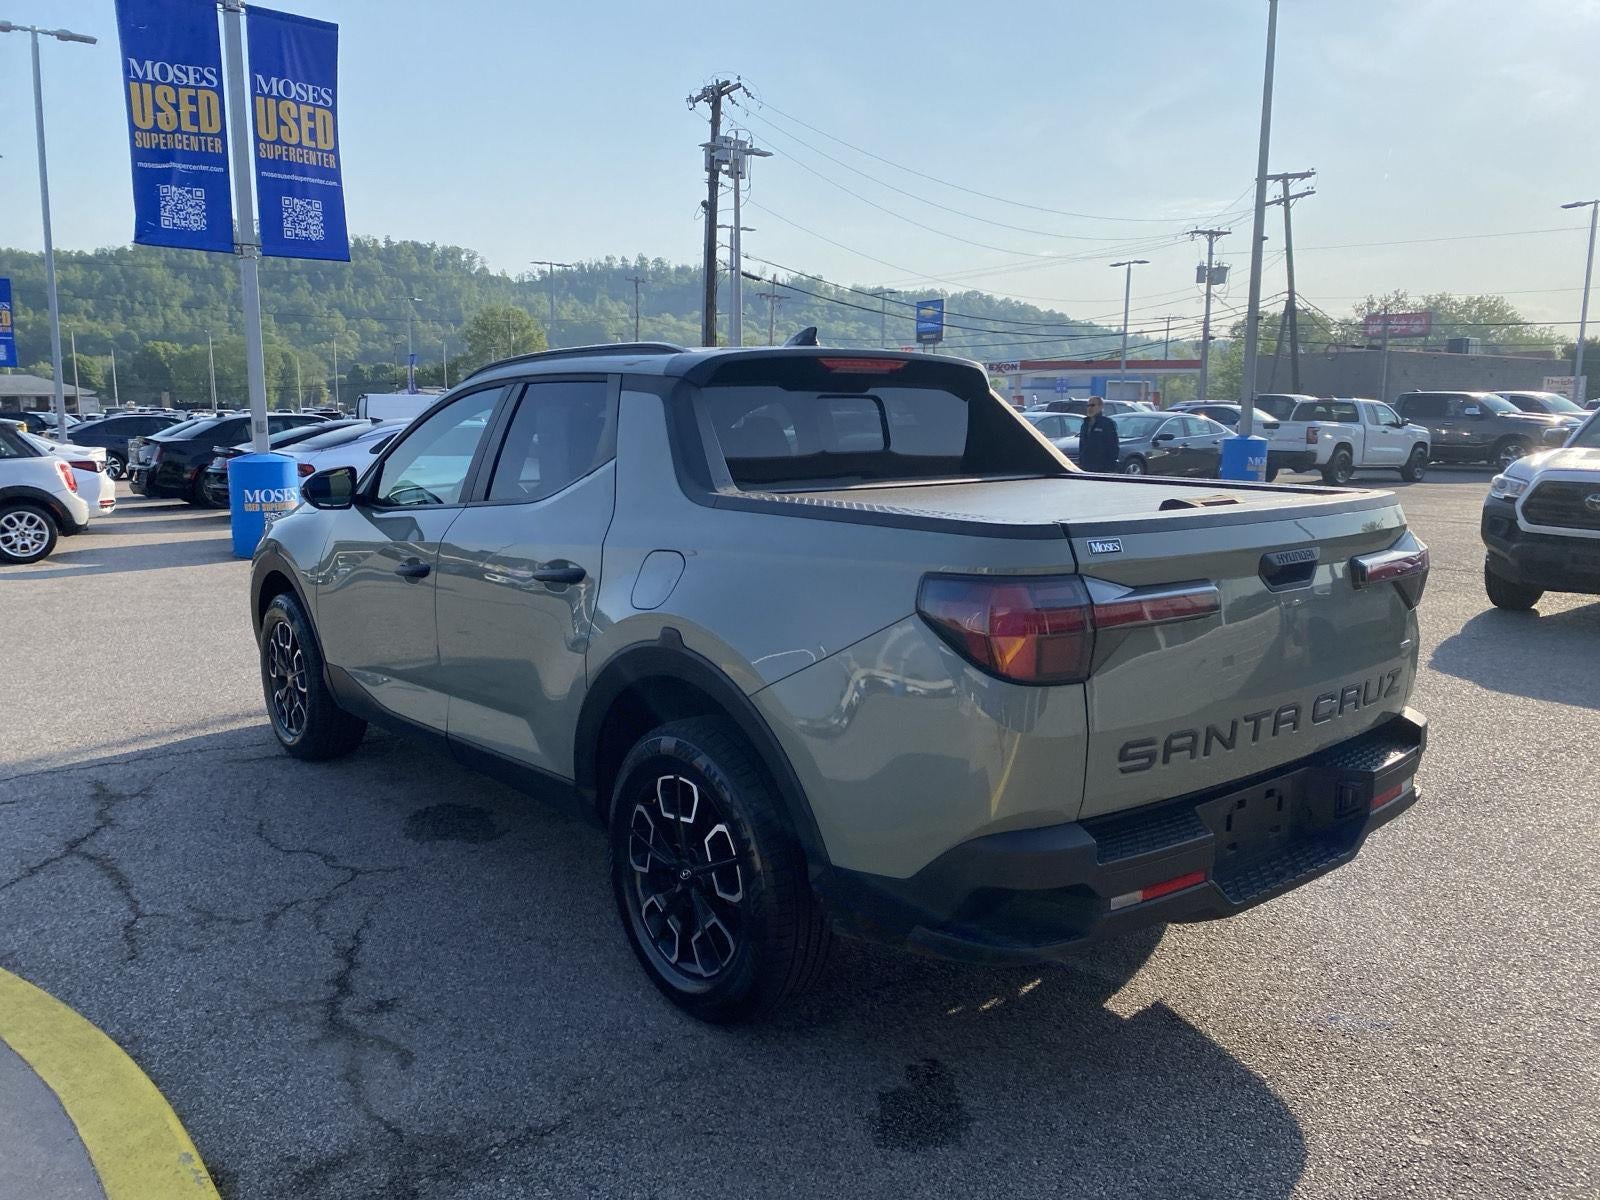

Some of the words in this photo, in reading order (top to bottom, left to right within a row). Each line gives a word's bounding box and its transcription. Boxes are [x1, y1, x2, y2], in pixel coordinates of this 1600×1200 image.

[128, 57, 218, 87] MOSES
[255, 74, 333, 107] MOSES
[130, 82, 221, 134] USED
[256, 96, 335, 151] USED
[135, 131, 223, 153] SUPERCENTER
[137, 160, 224, 173] mosesusedsupercenter.com
[259, 142, 337, 169] SUPERCENTER
[261, 171, 337, 186] mosesusedsupercenter.com
[988, 362, 1018, 373] EXXON
[244, 488, 297, 503] MOSES
[1090, 542, 1120, 553] MOSES
[1277, 550, 1315, 564] HYUNDAI
[1118, 702, 1302, 774] SANTA
[1312, 668, 1402, 726] CRUZ
